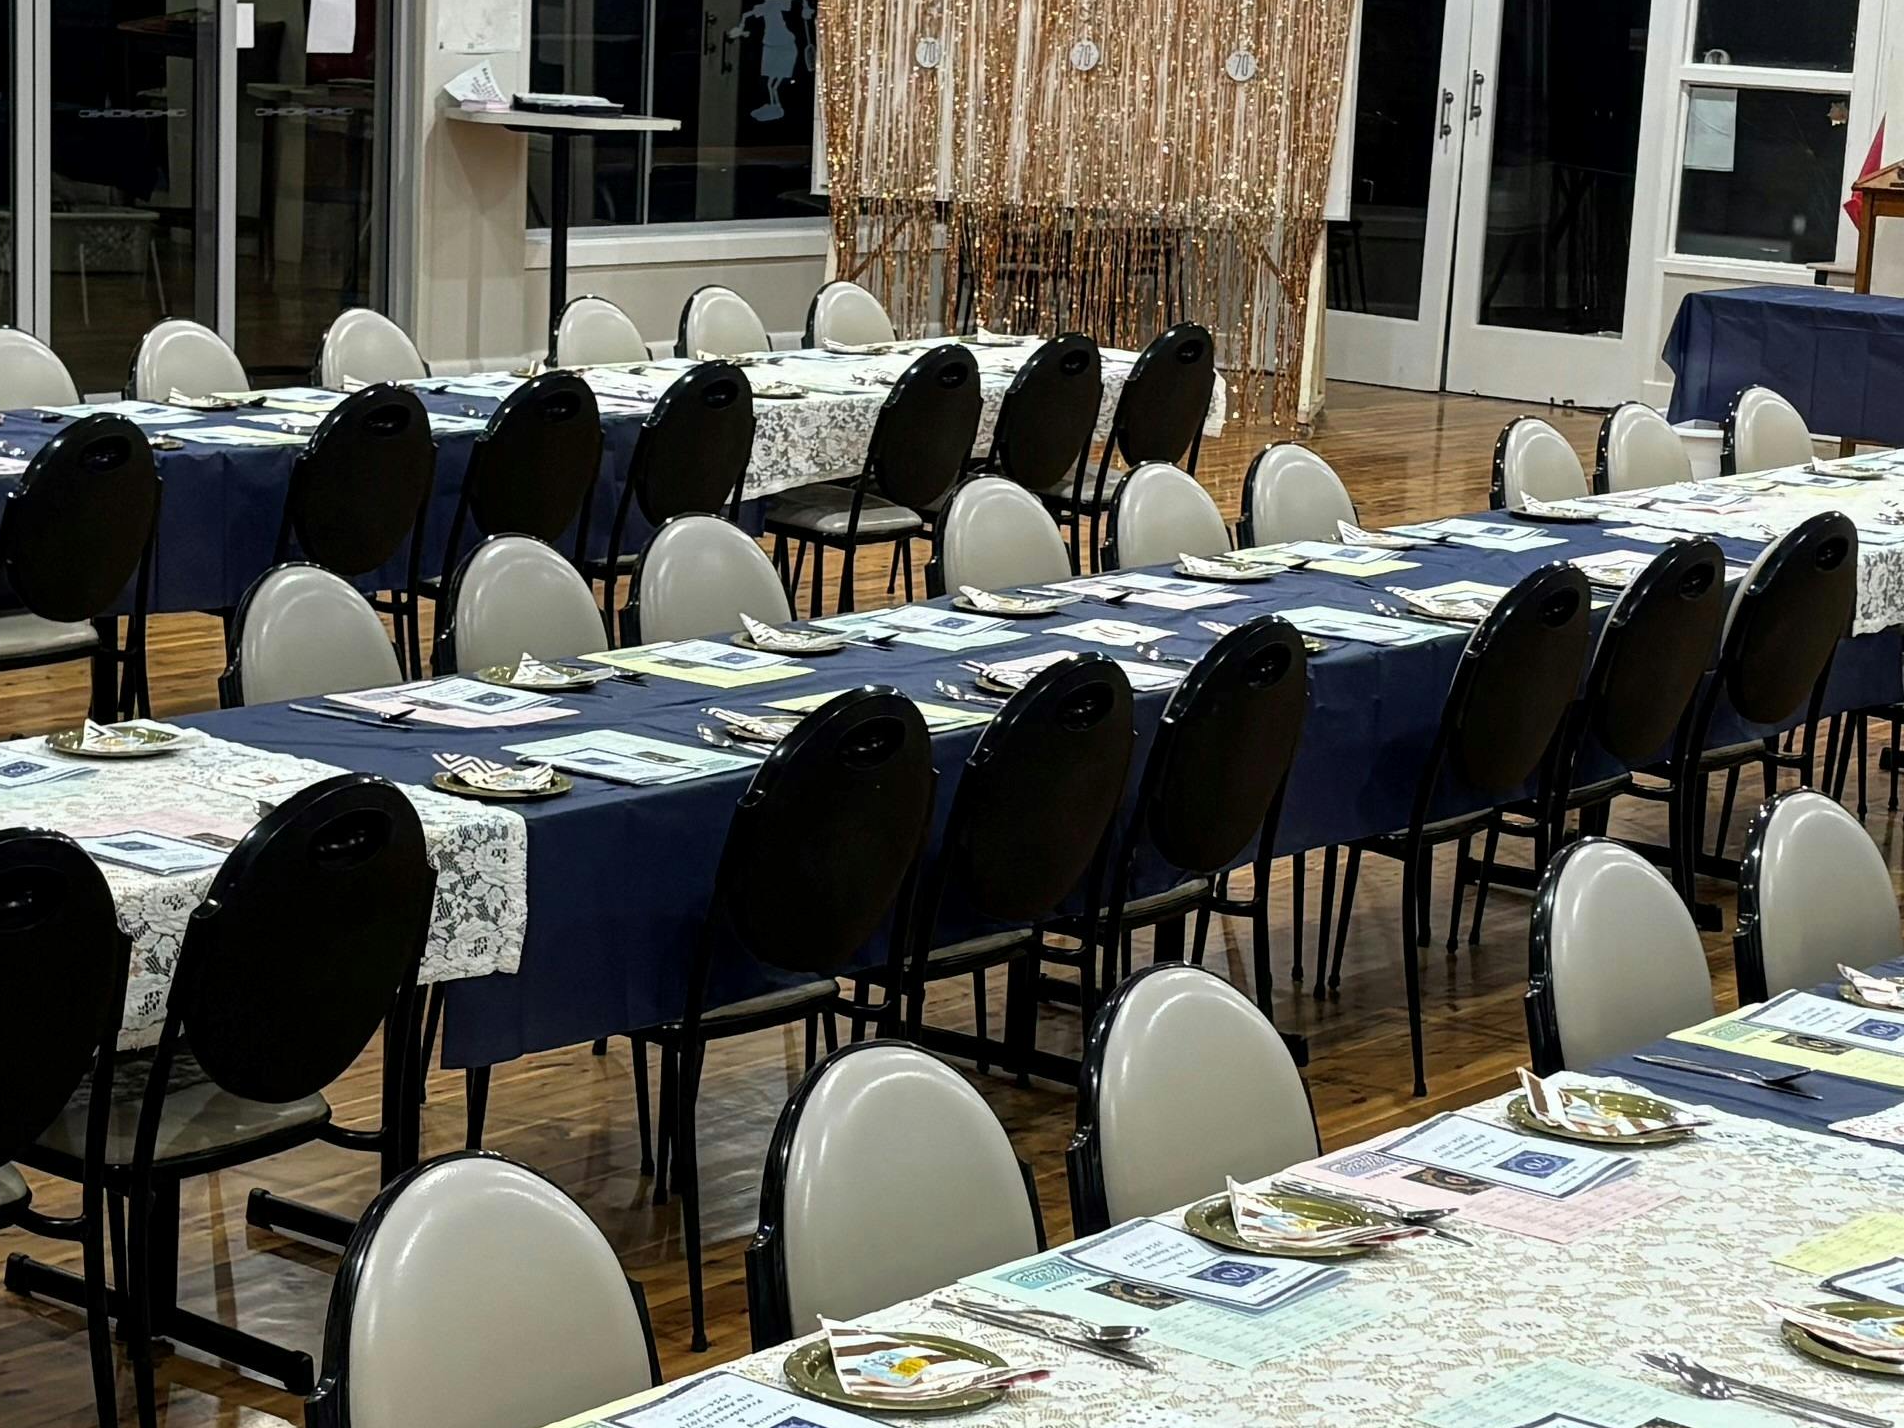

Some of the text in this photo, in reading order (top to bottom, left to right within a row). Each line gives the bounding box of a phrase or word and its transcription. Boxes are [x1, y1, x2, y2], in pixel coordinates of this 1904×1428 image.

[923, 41, 936, 63] 70
[1078, 44, 1091, 67] 70
[1234, 54, 1247, 76] 70
[1525, 1158, 1547, 1171] 70
[1221, 1265, 1249, 1279] 70
